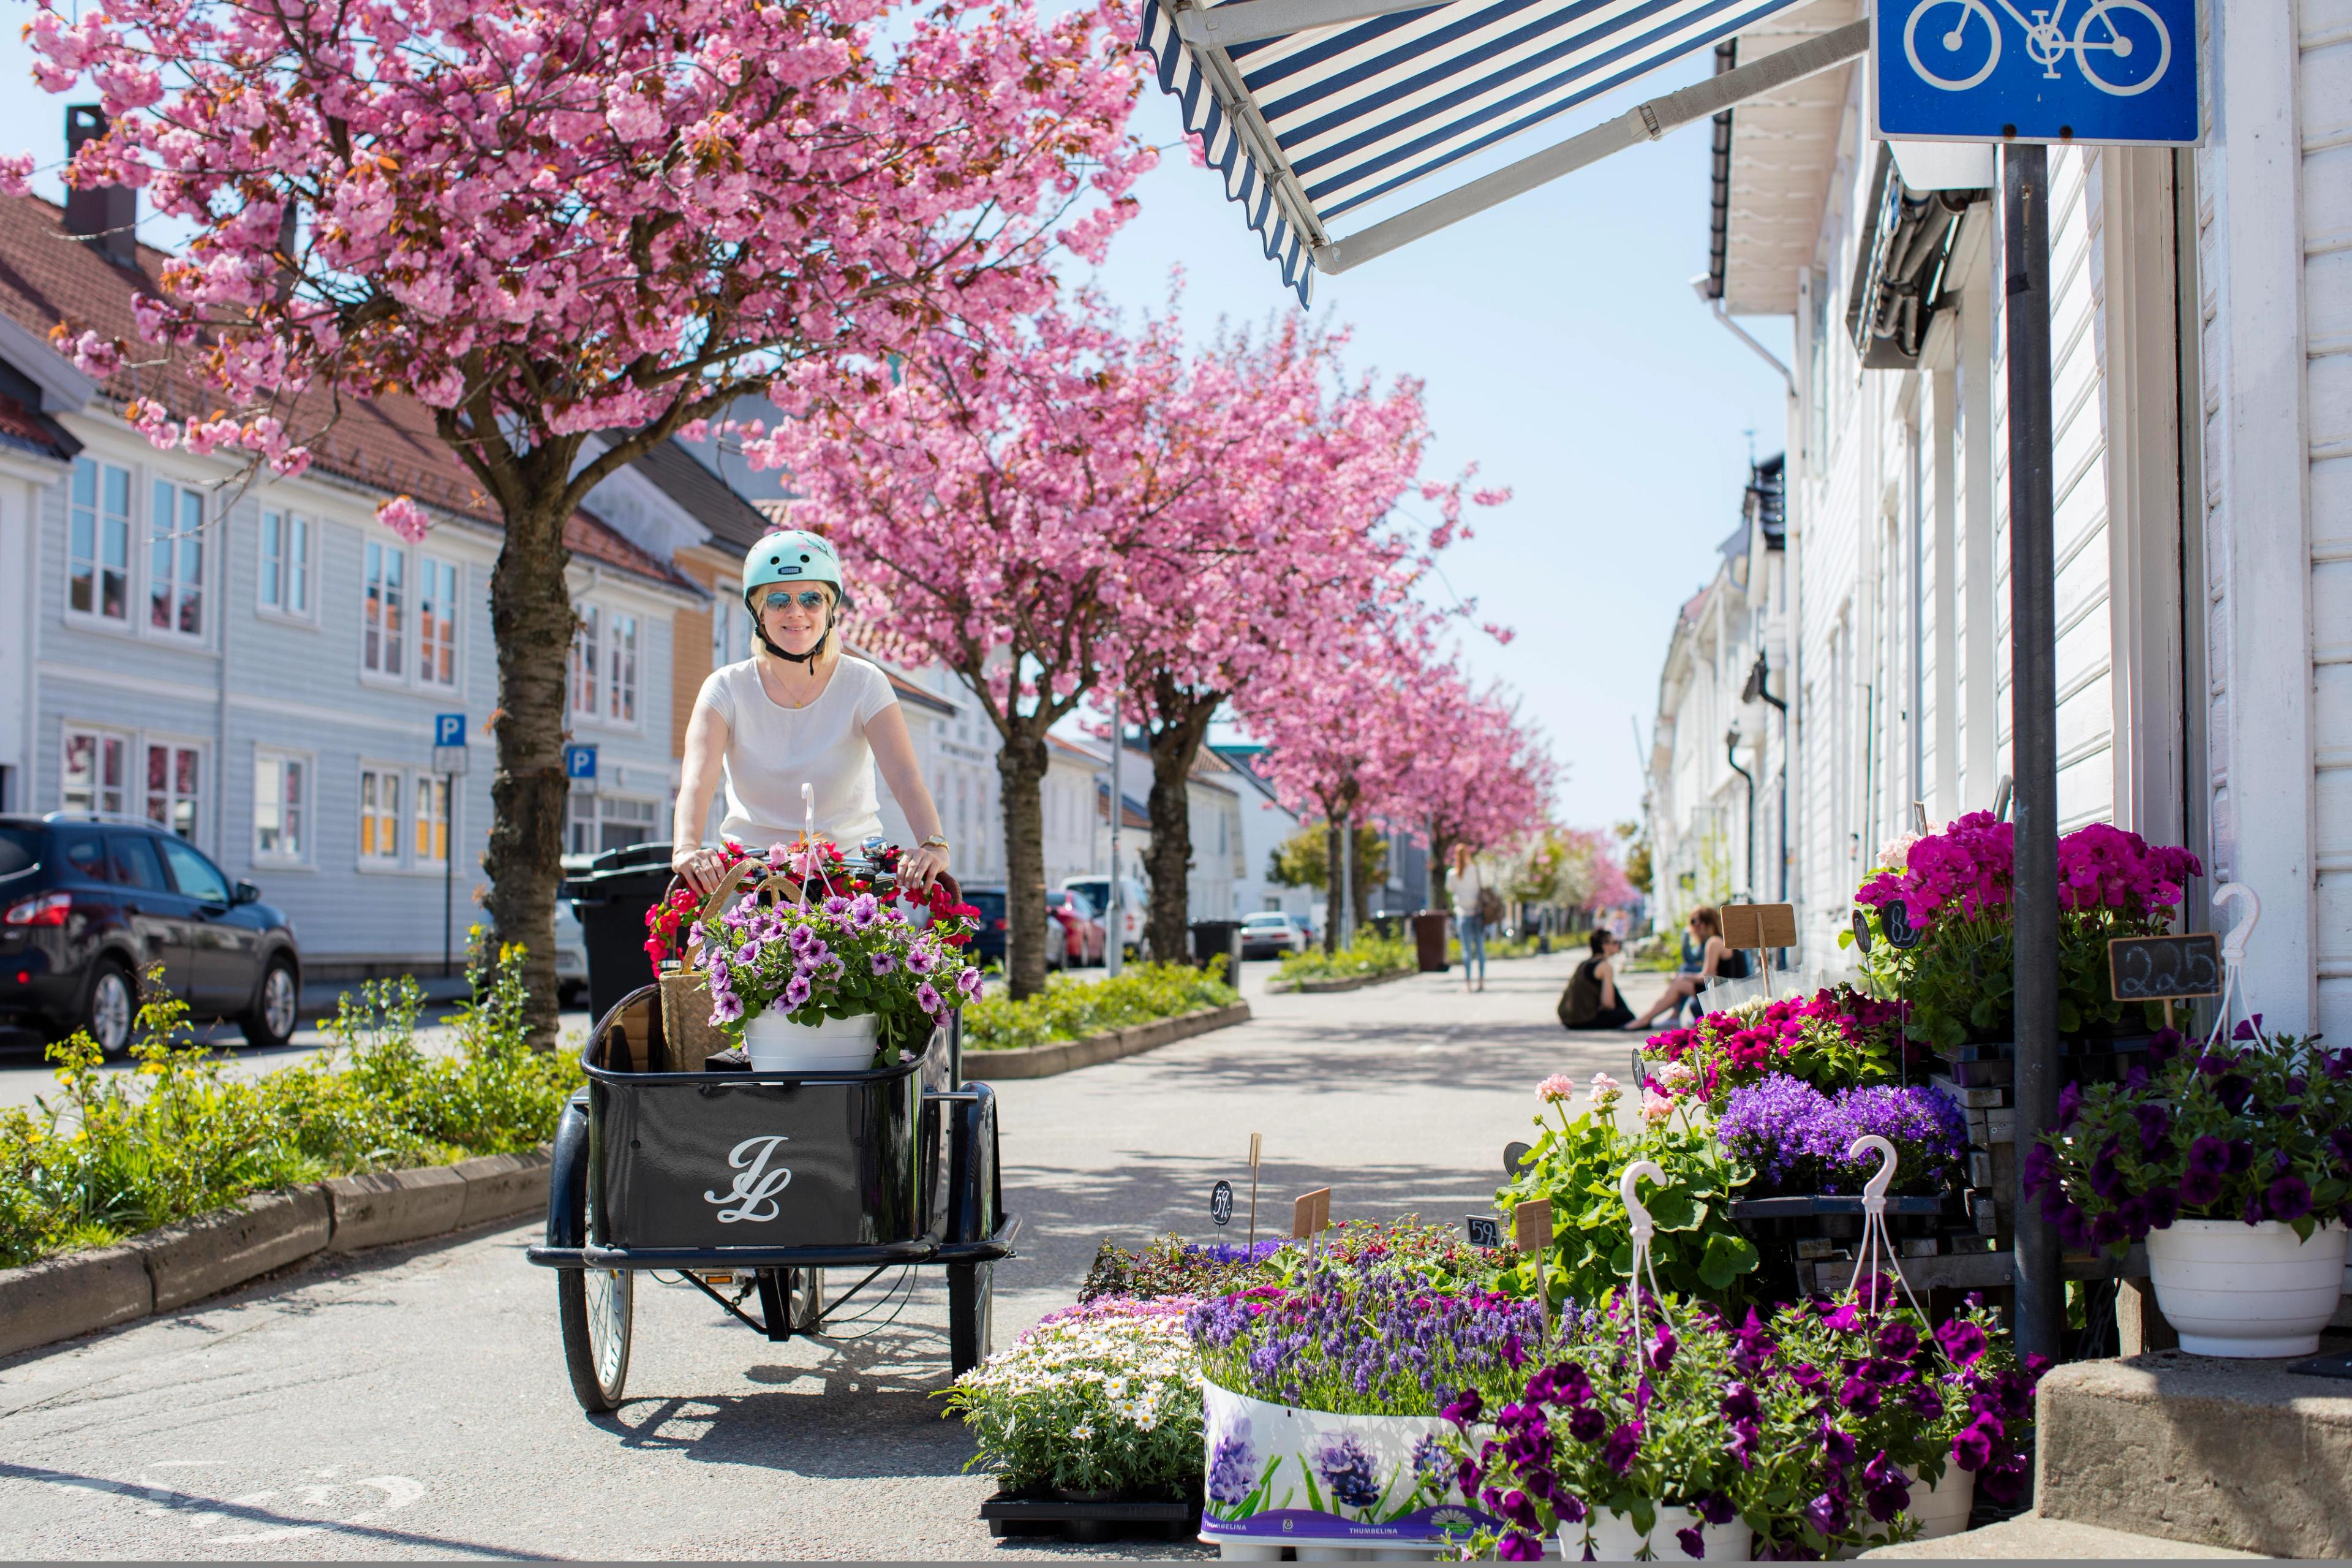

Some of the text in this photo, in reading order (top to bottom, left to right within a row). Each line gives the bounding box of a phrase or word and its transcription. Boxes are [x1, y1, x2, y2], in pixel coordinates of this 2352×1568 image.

[442, 717, 459, 743] P
[574, 752, 589, 774] P
[1204, 1520, 1246, 1531] THUMBELINA
